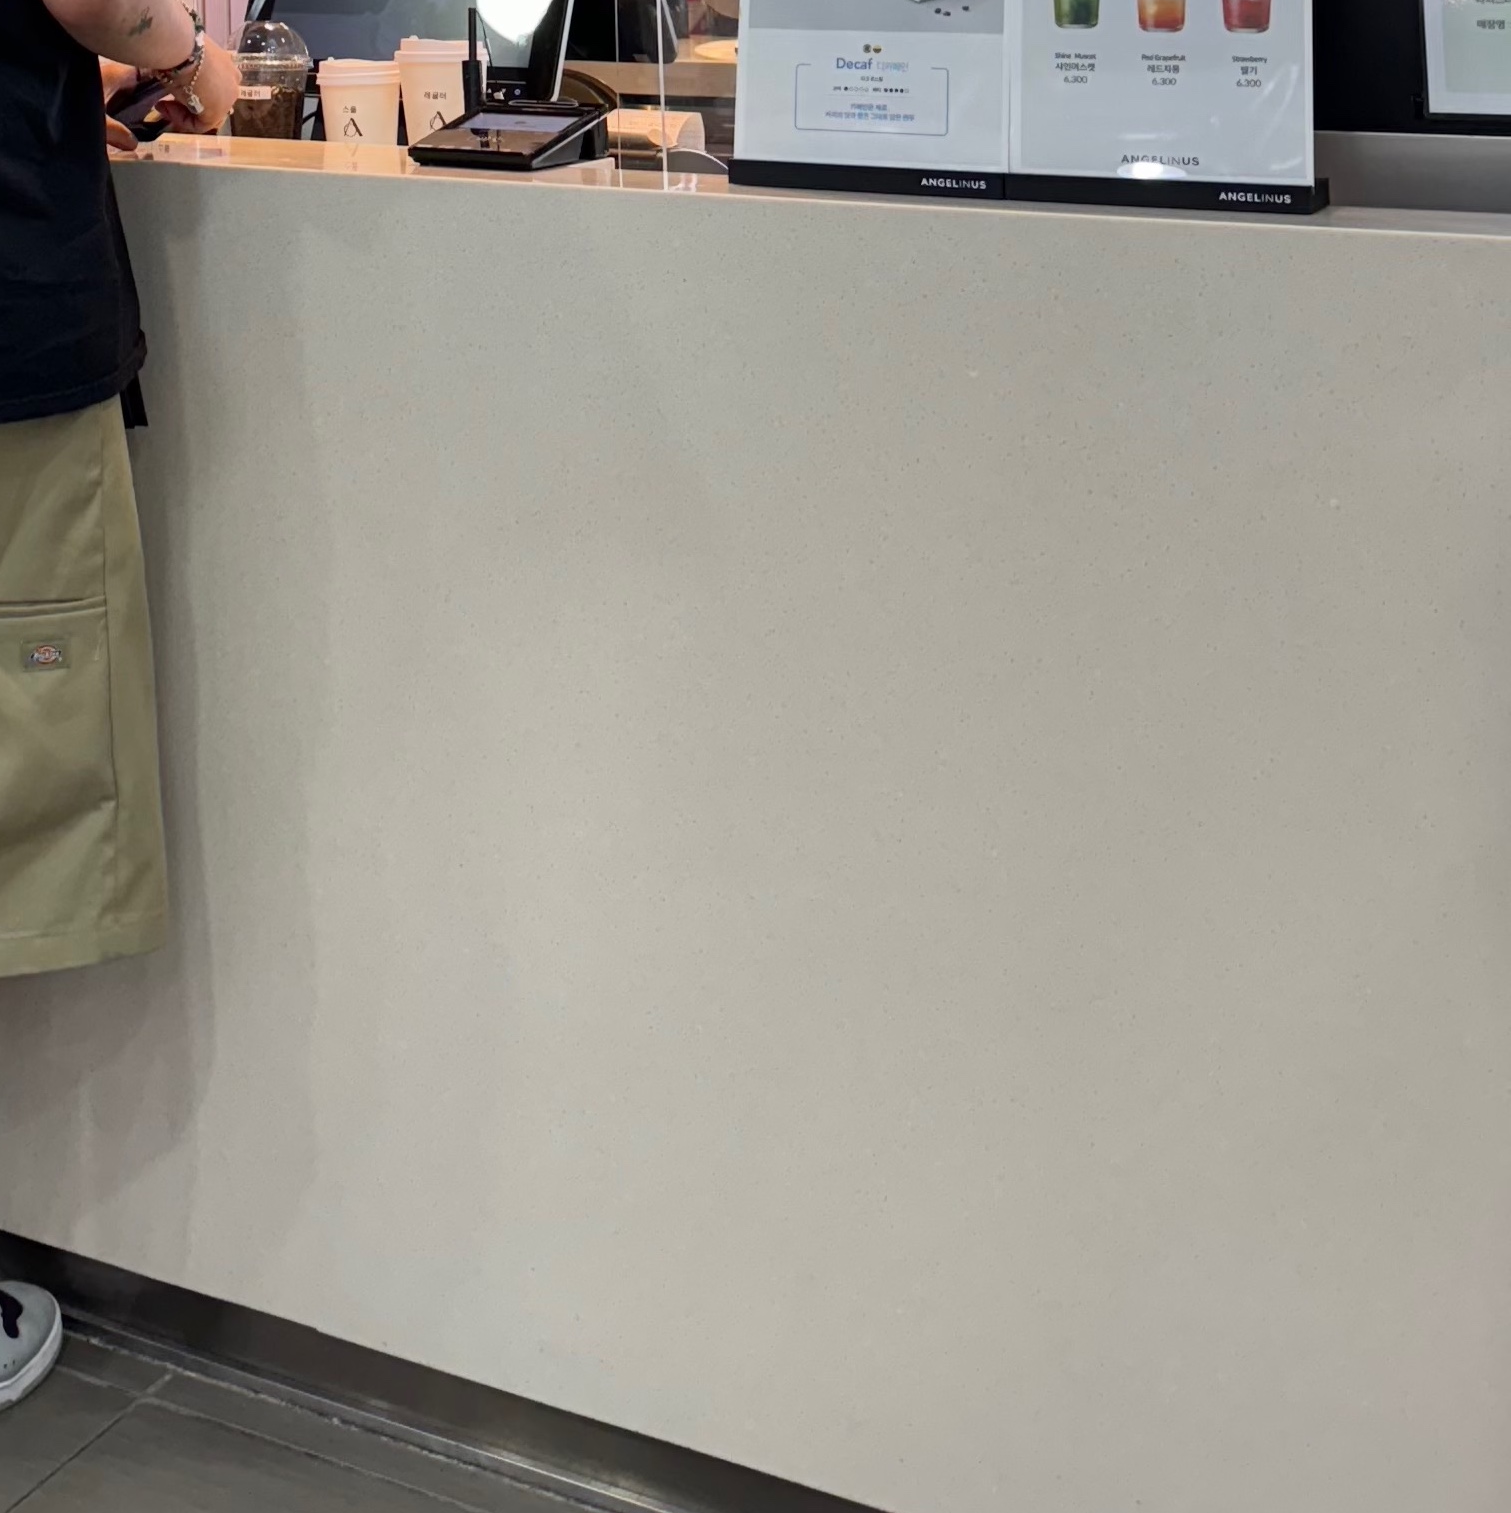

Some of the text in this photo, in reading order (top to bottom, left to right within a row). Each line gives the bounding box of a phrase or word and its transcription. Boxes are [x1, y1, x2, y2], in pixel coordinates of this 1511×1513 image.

[836, 57, 873, 70] Decaf
[1121, 153, 1199, 166] ANGELINUS
[920, 177, 986, 190] ANGELINUS
[1219, 191, 1292, 204] ANGELINUS
